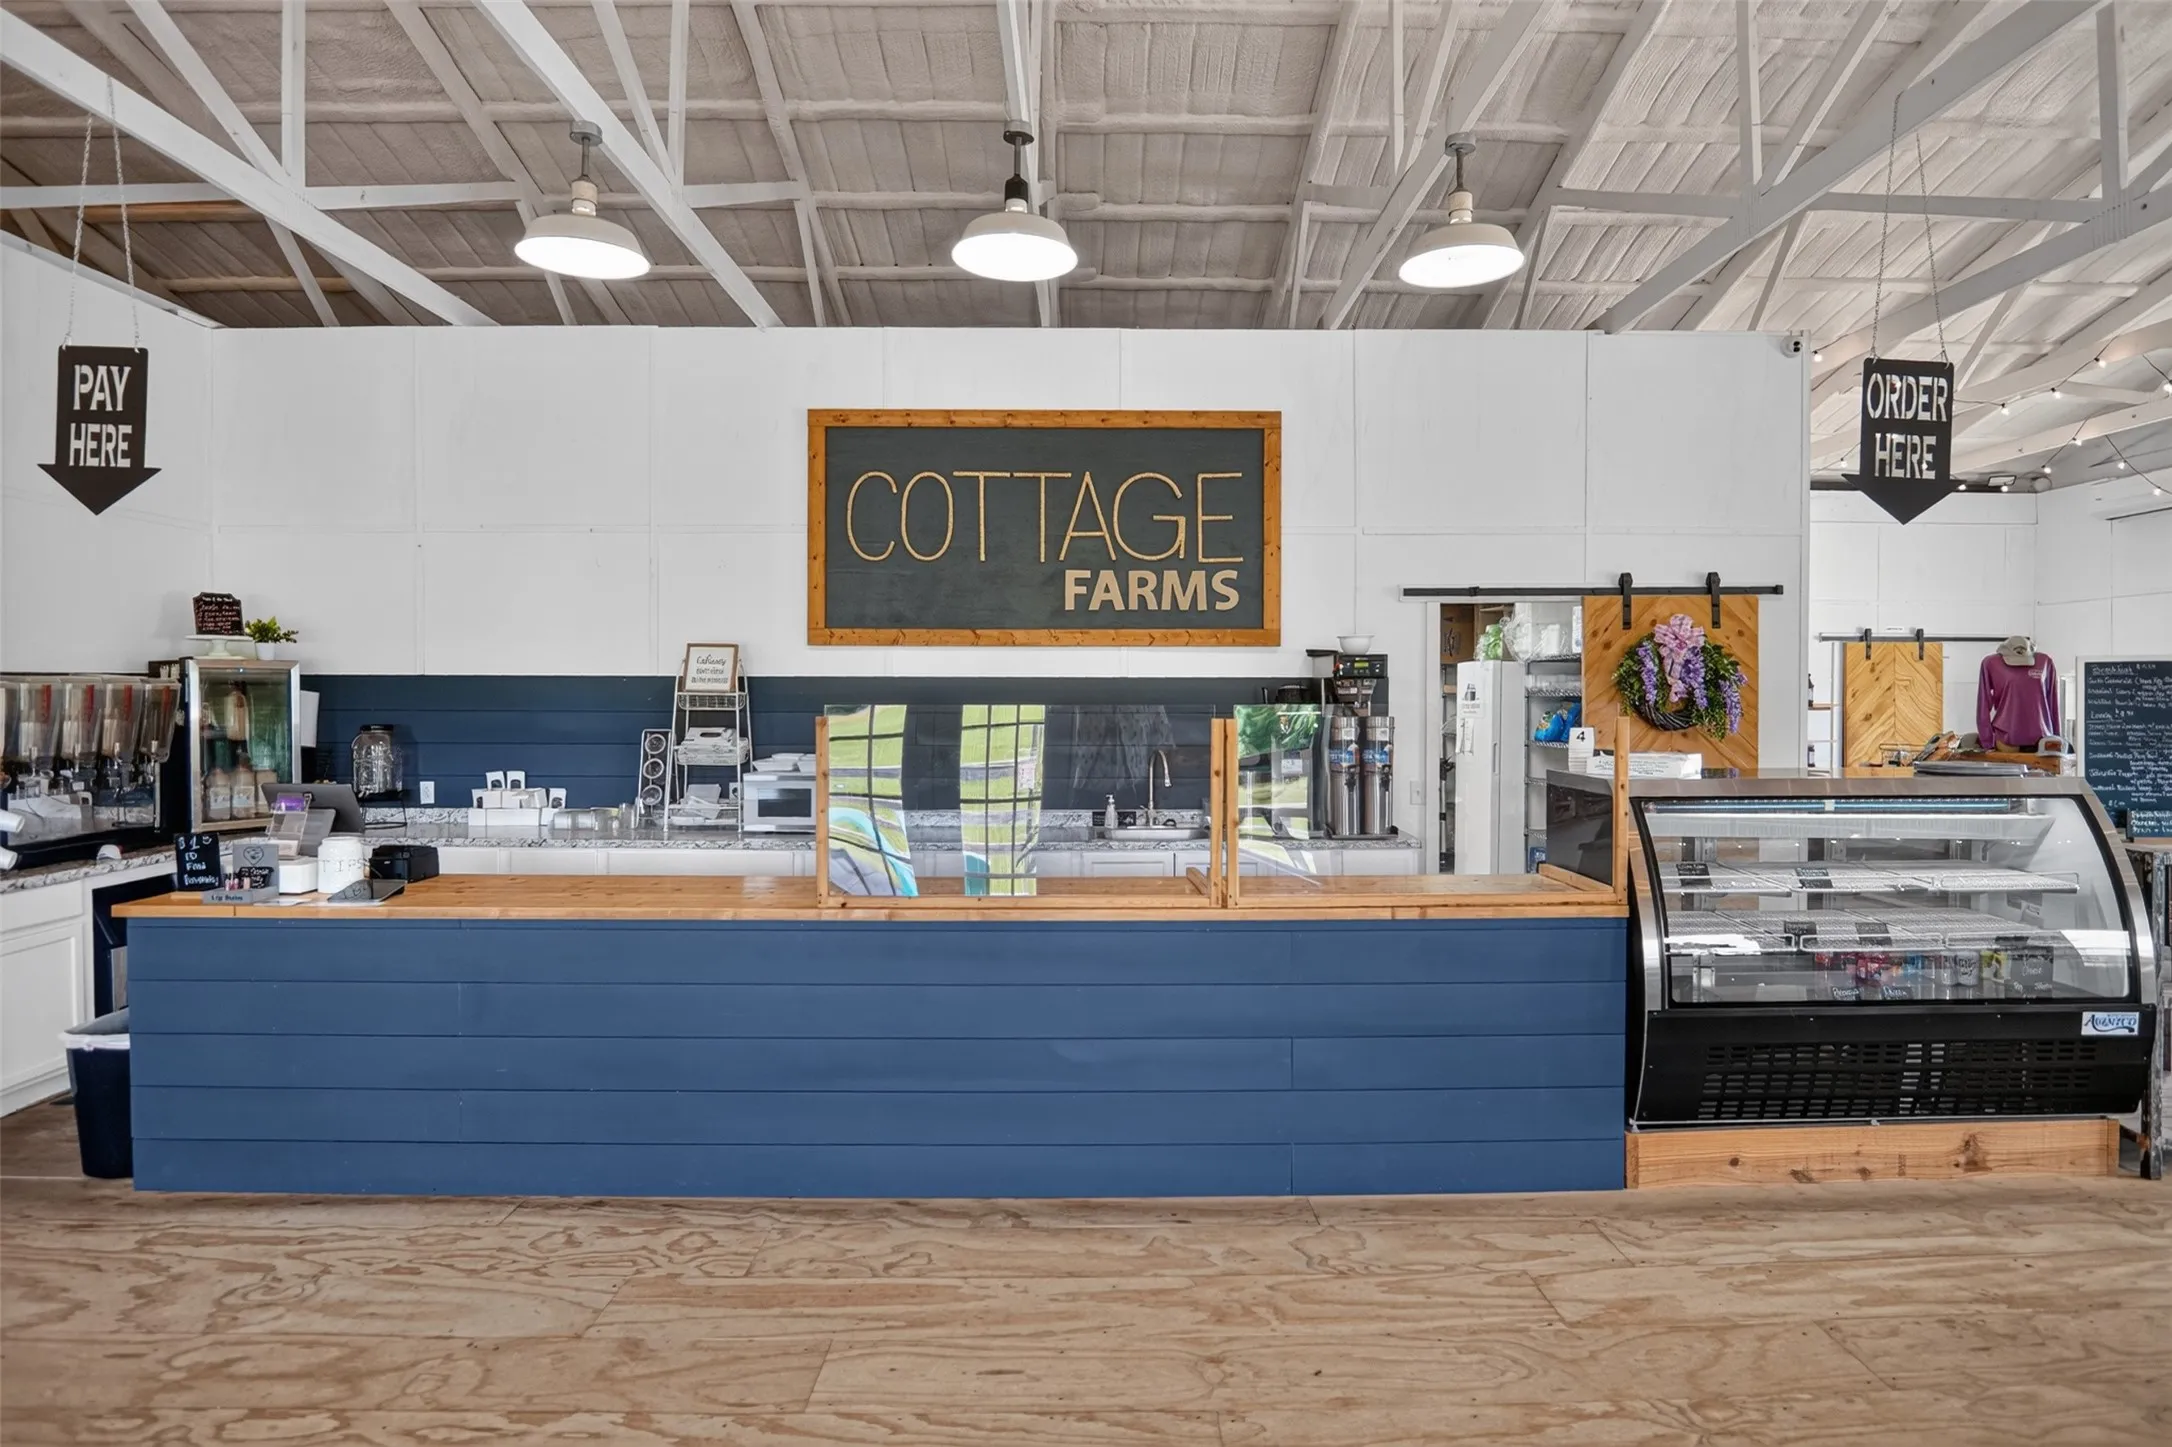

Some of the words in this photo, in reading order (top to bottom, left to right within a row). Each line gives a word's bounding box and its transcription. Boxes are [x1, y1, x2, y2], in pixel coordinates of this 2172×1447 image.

[73, 364, 131, 411] PAY
[1866, 372, 1948, 422] ORDER
[69, 422, 132, 468] HERE
[1874, 432, 1937, 480] HERE
[846, 470, 1244, 563] COTTAGE
[1065, 569, 1239, 611] FARMS
[1575, 730, 1586, 742] 4
